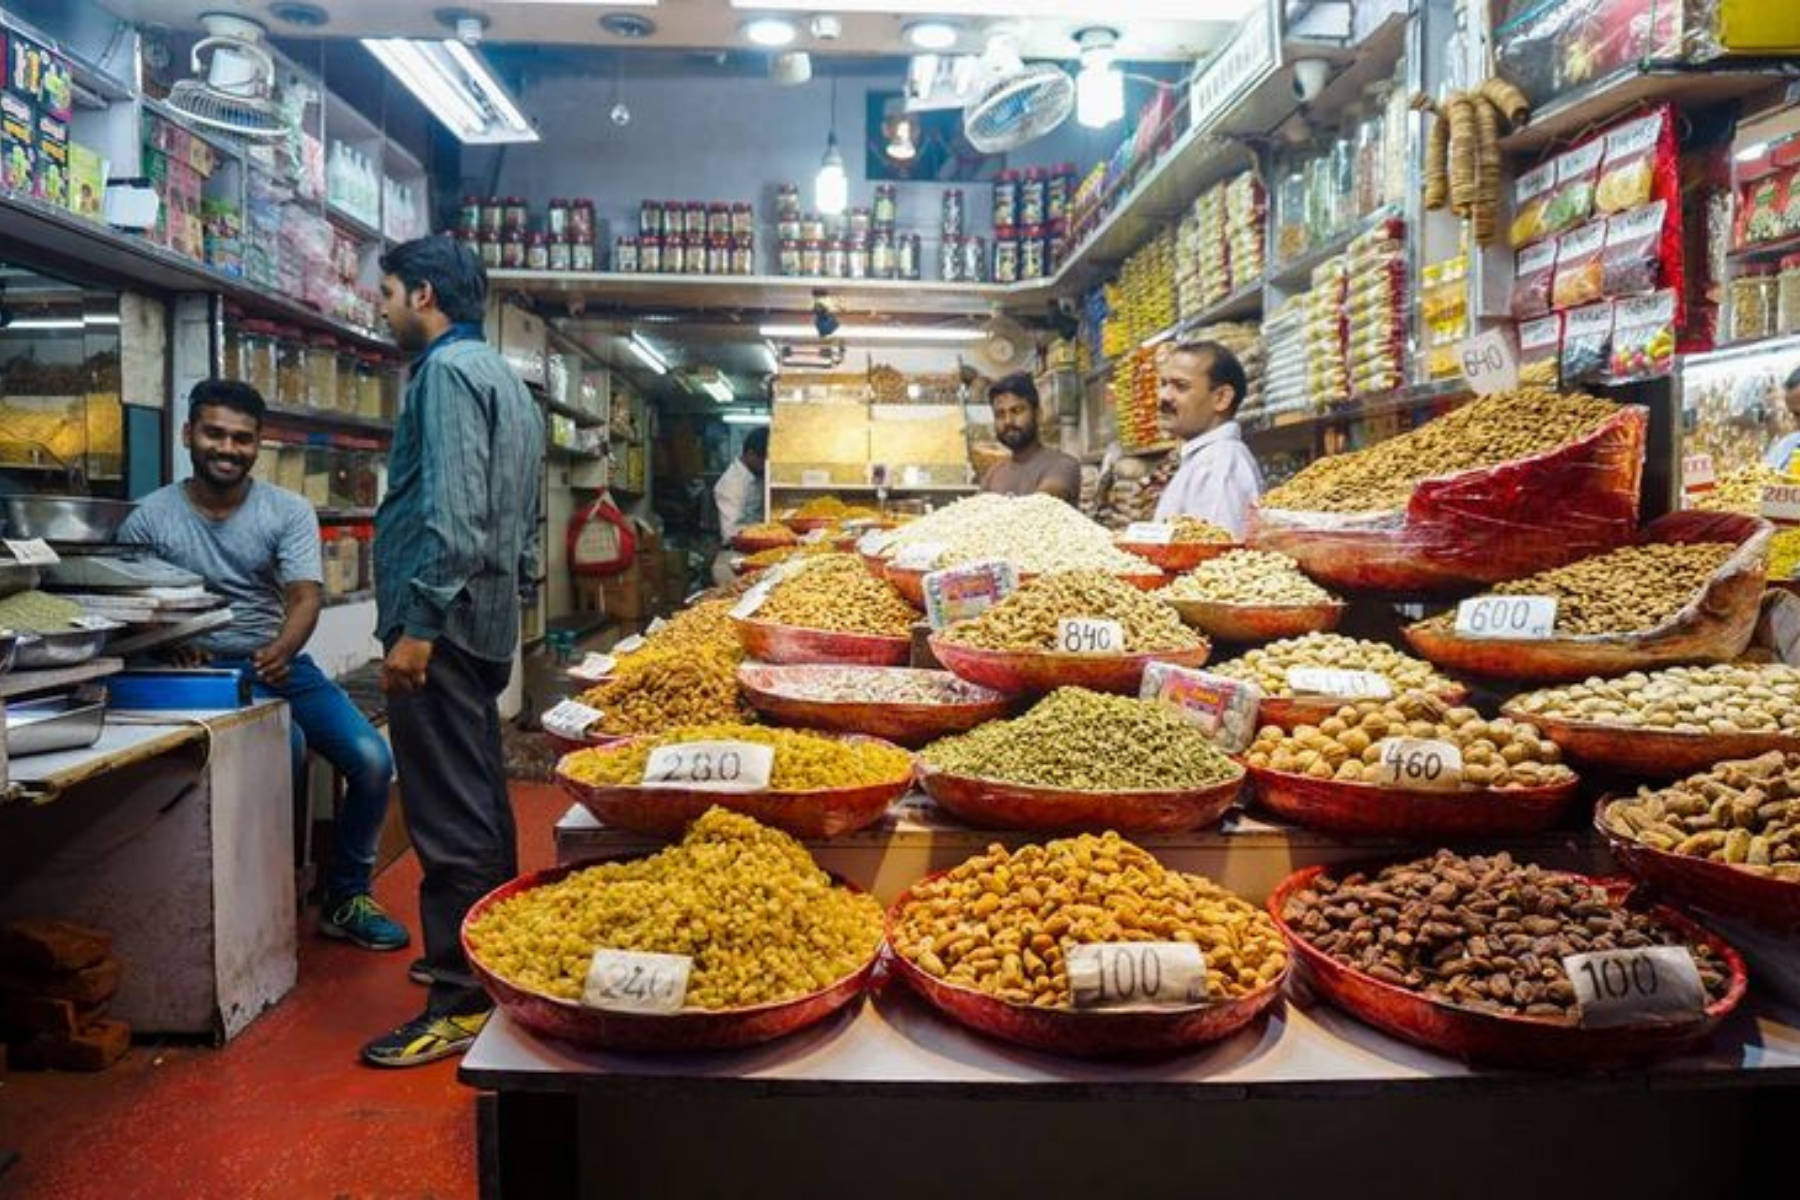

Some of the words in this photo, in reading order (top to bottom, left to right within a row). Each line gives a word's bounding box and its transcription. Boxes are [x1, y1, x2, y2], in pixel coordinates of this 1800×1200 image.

[1471, 600, 1531, 631] 600
[1065, 622, 1111, 652] 840
[661, 752, 741, 782] 280
[1386, 743, 1442, 781] 460
[1094, 948, 1161, 999] 100
[1580, 954, 1658, 1000] 100
